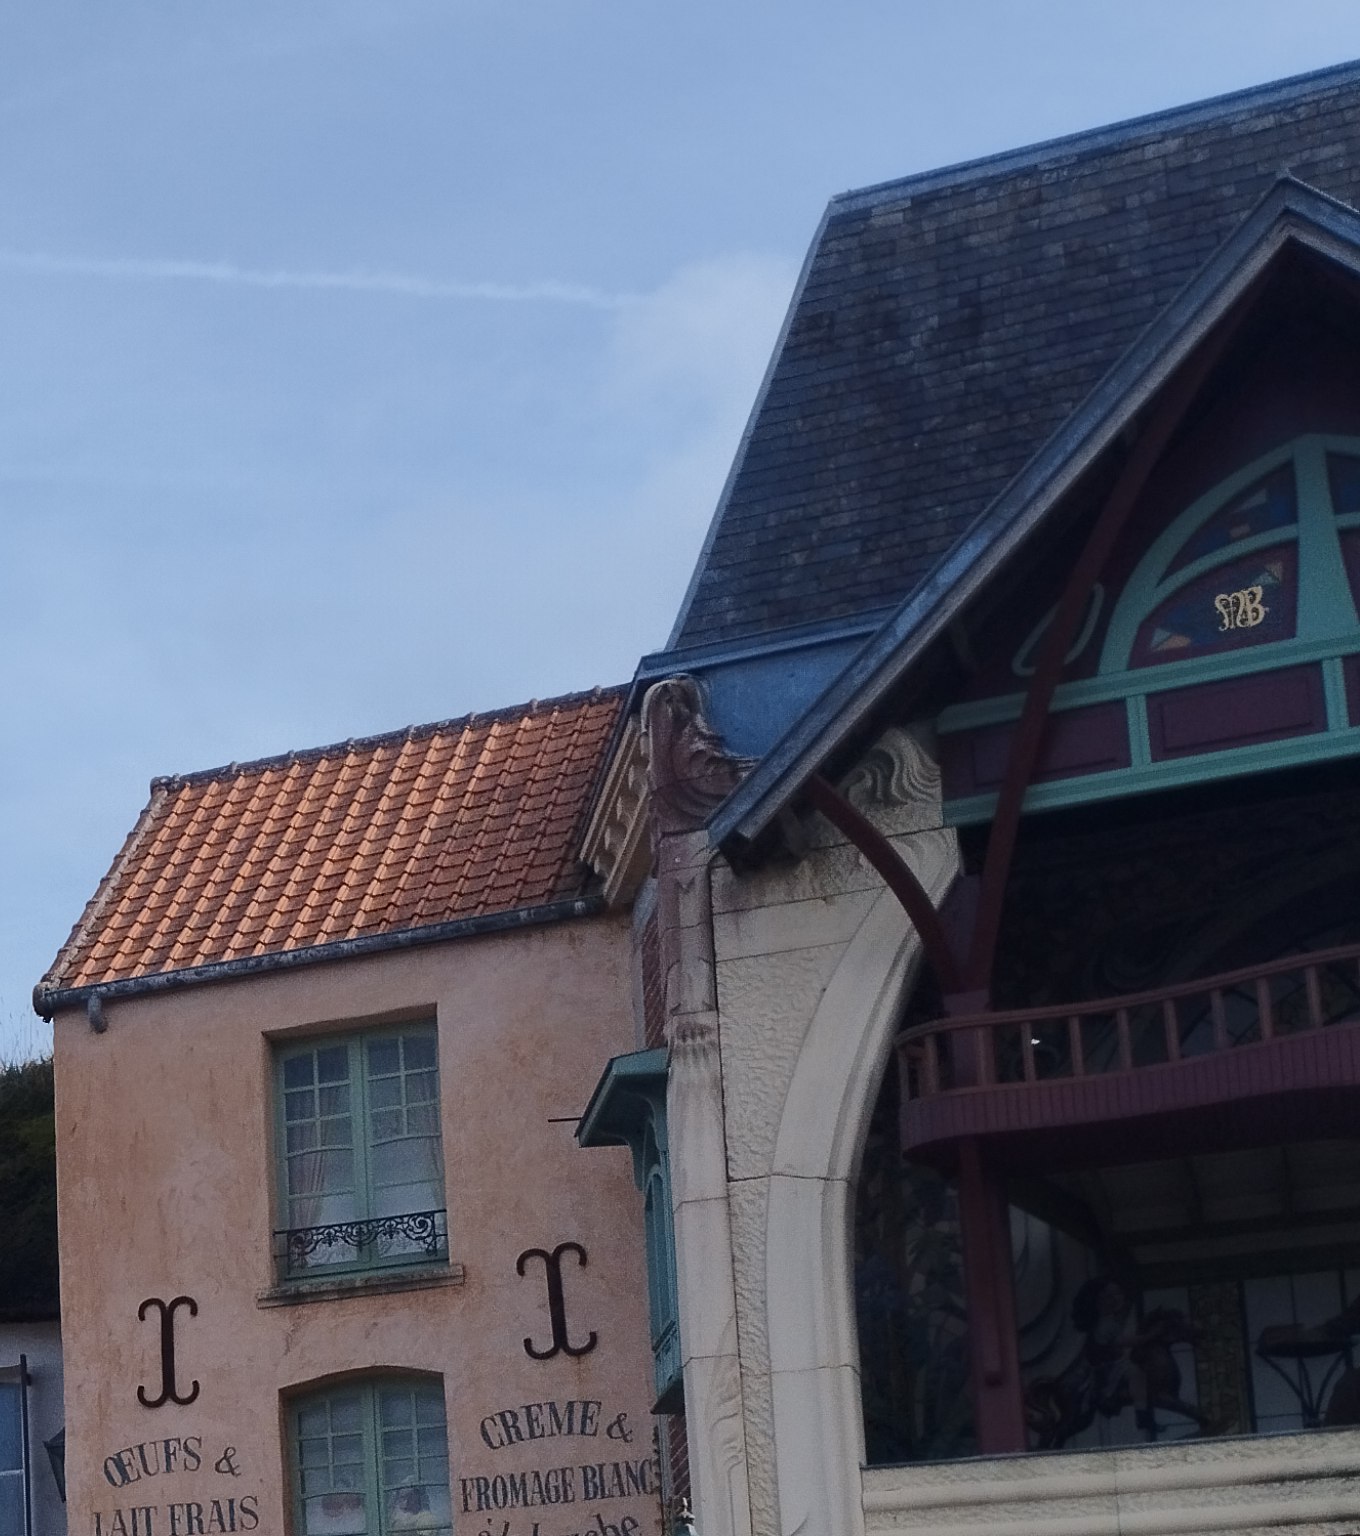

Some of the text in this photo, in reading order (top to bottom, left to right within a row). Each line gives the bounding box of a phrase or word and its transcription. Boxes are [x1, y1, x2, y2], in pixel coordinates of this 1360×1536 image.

[480, 1400, 633, 1450] CREME &
[104, 1436, 242, 1487] ŒUFS &
[459, 1458, 655, 1513] FROMAGE BLANC
